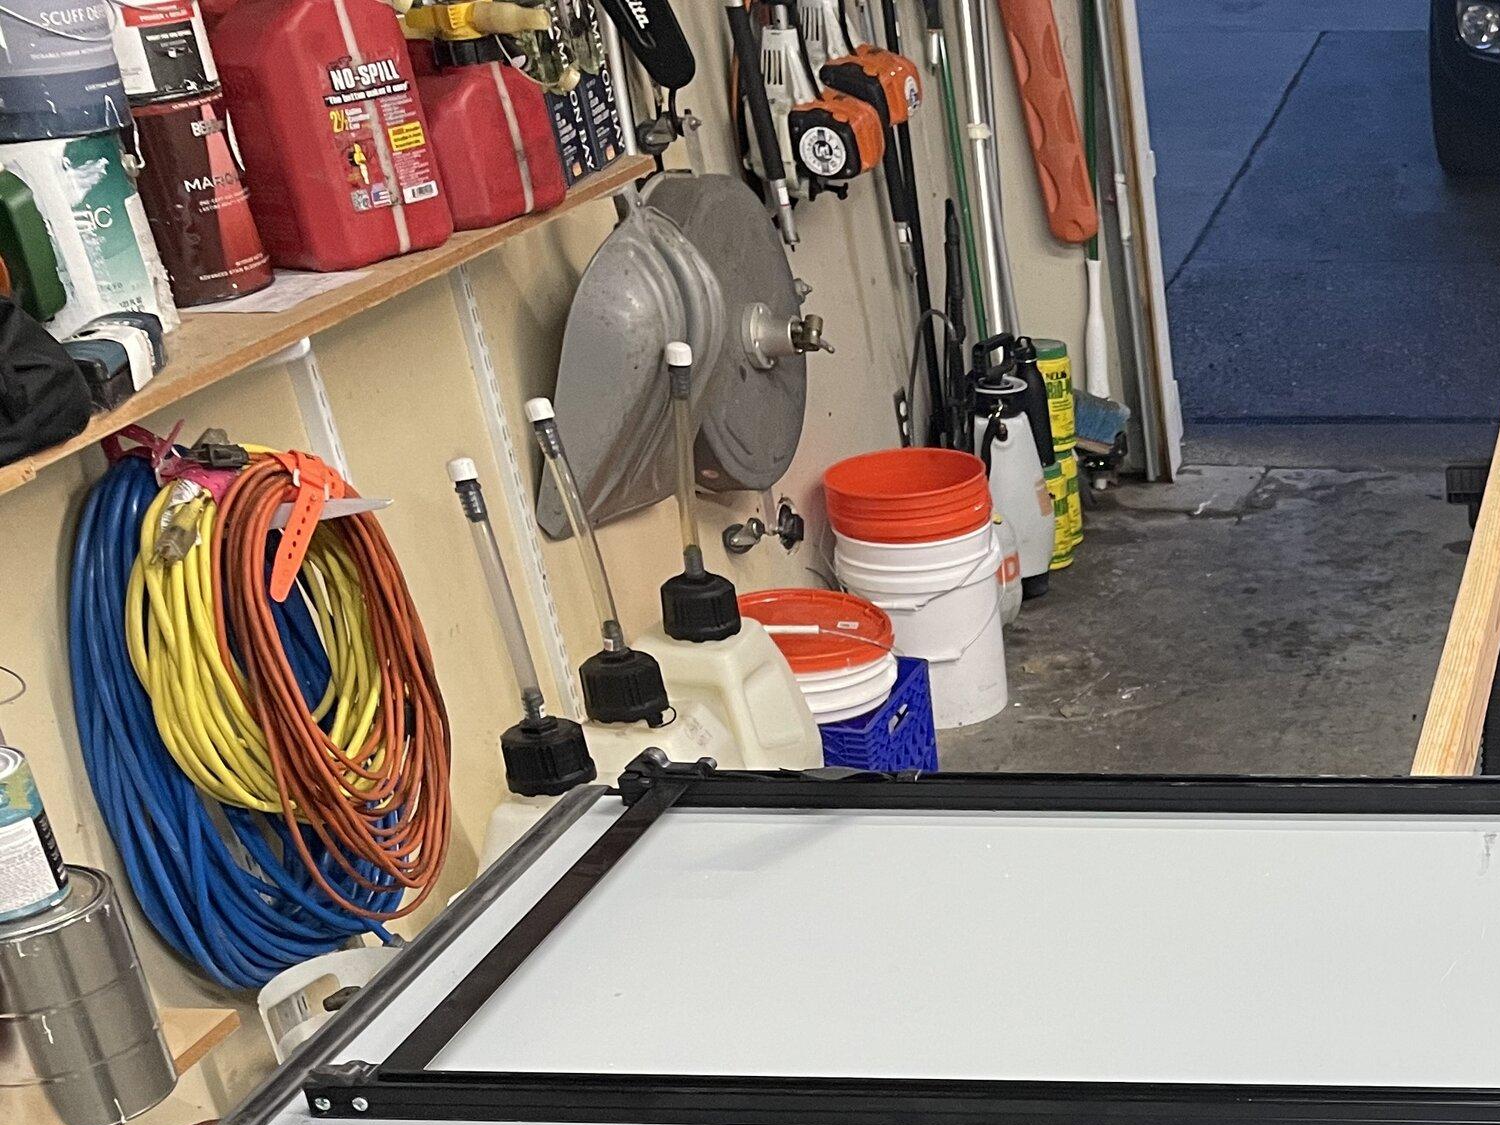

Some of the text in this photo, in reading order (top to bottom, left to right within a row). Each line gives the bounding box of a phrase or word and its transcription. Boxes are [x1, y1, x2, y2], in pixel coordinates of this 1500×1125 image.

[40, 7, 84, 26] SCUFF
[329, 59, 400, 91] NO-SPILL
[549, 6, 583, 123] HAMON
[578, 129, 595, 168] BAY
